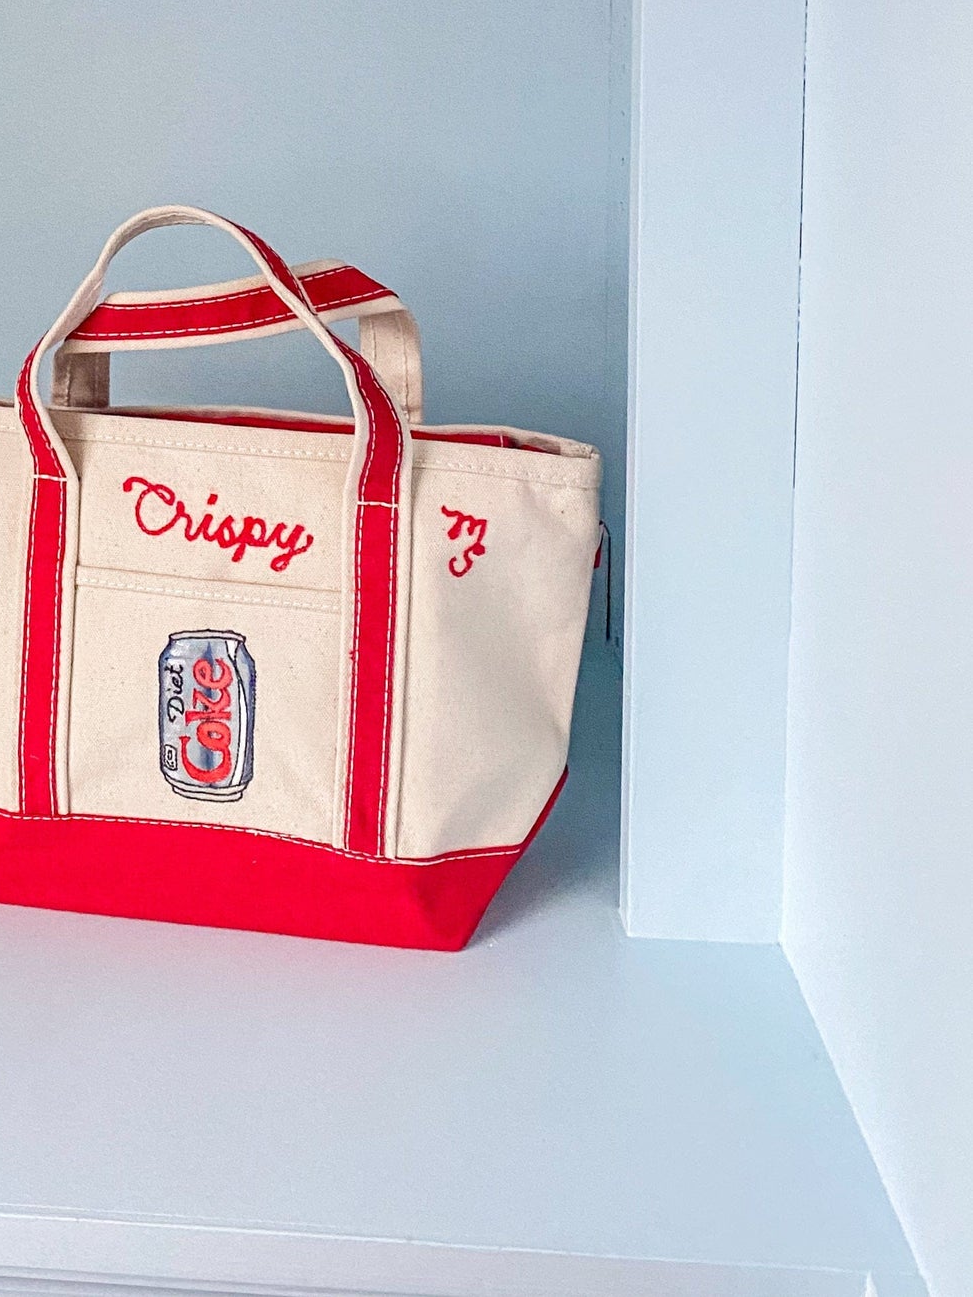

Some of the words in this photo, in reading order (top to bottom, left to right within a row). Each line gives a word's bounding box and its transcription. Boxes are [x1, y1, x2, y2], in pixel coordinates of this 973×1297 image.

[122, 476, 313, 572] Crispy
[164, 663, 185, 724] Diet
[179, 657, 233, 784] Coke
